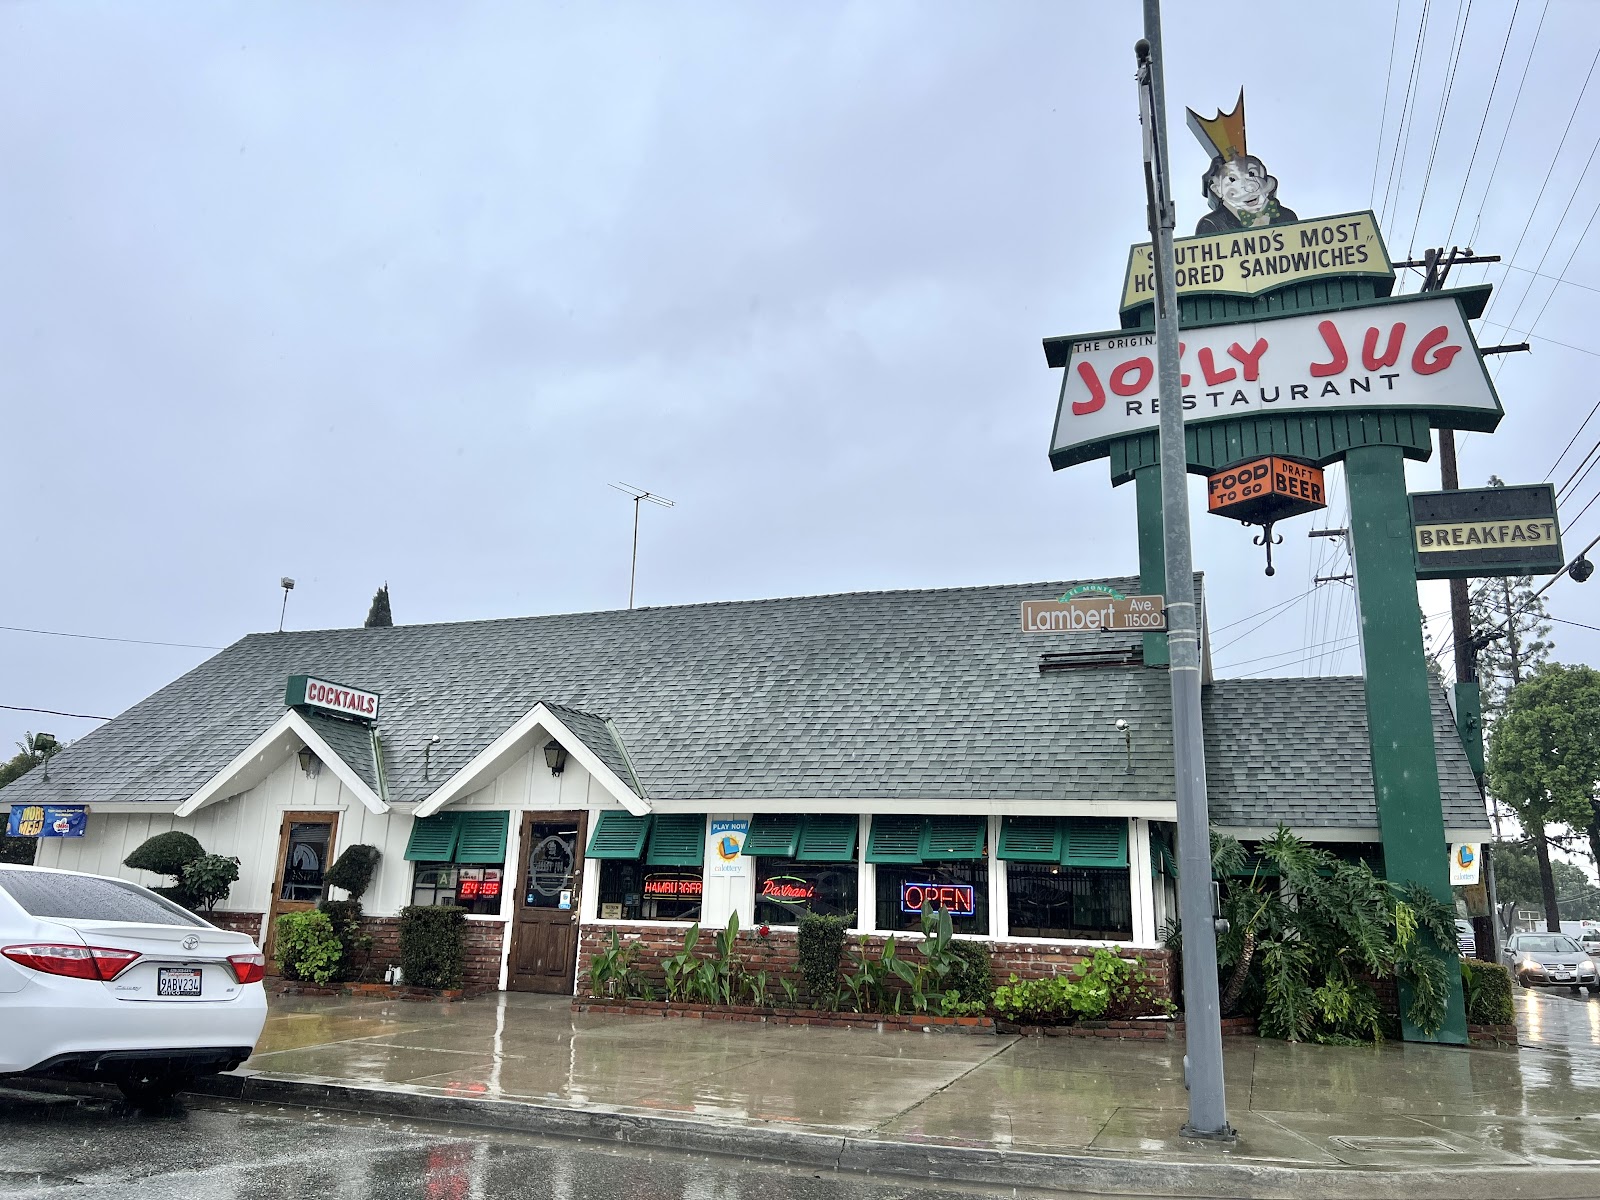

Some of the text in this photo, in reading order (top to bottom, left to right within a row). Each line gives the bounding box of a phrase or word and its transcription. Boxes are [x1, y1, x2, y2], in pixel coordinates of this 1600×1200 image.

[1300, 222, 1361, 248] MOST
[1135, 264, 1224, 292] HOORED
[1074, 341, 1100, 353] THE
[1310, 320, 1462, 376] JUG
[1209, 464, 1269, 494] FOOD
[1283, 463, 1313, 480] DRAFT
[1217, 483, 1262, 504] TO GO
[1276, 472, 1321, 501] BEER
[1419, 523, 1554, 547] BREAKFAST
[1069, 585, 1112, 596] EL MONTE
[1129, 599, 1155, 612] Ave.
[1027, 603, 1116, 630] Lambert
[1124, 612, 1161, 627] 11500
[308, 683, 375, 715] COCKTAILS
[21, 806, 45, 821] MORE
[440, 873, 448, 884] A
[645, 881, 702, 894] HAMBURGER
[905, 886, 971, 911] OPEN
[161, 978, 199, 991] 9ABV234
